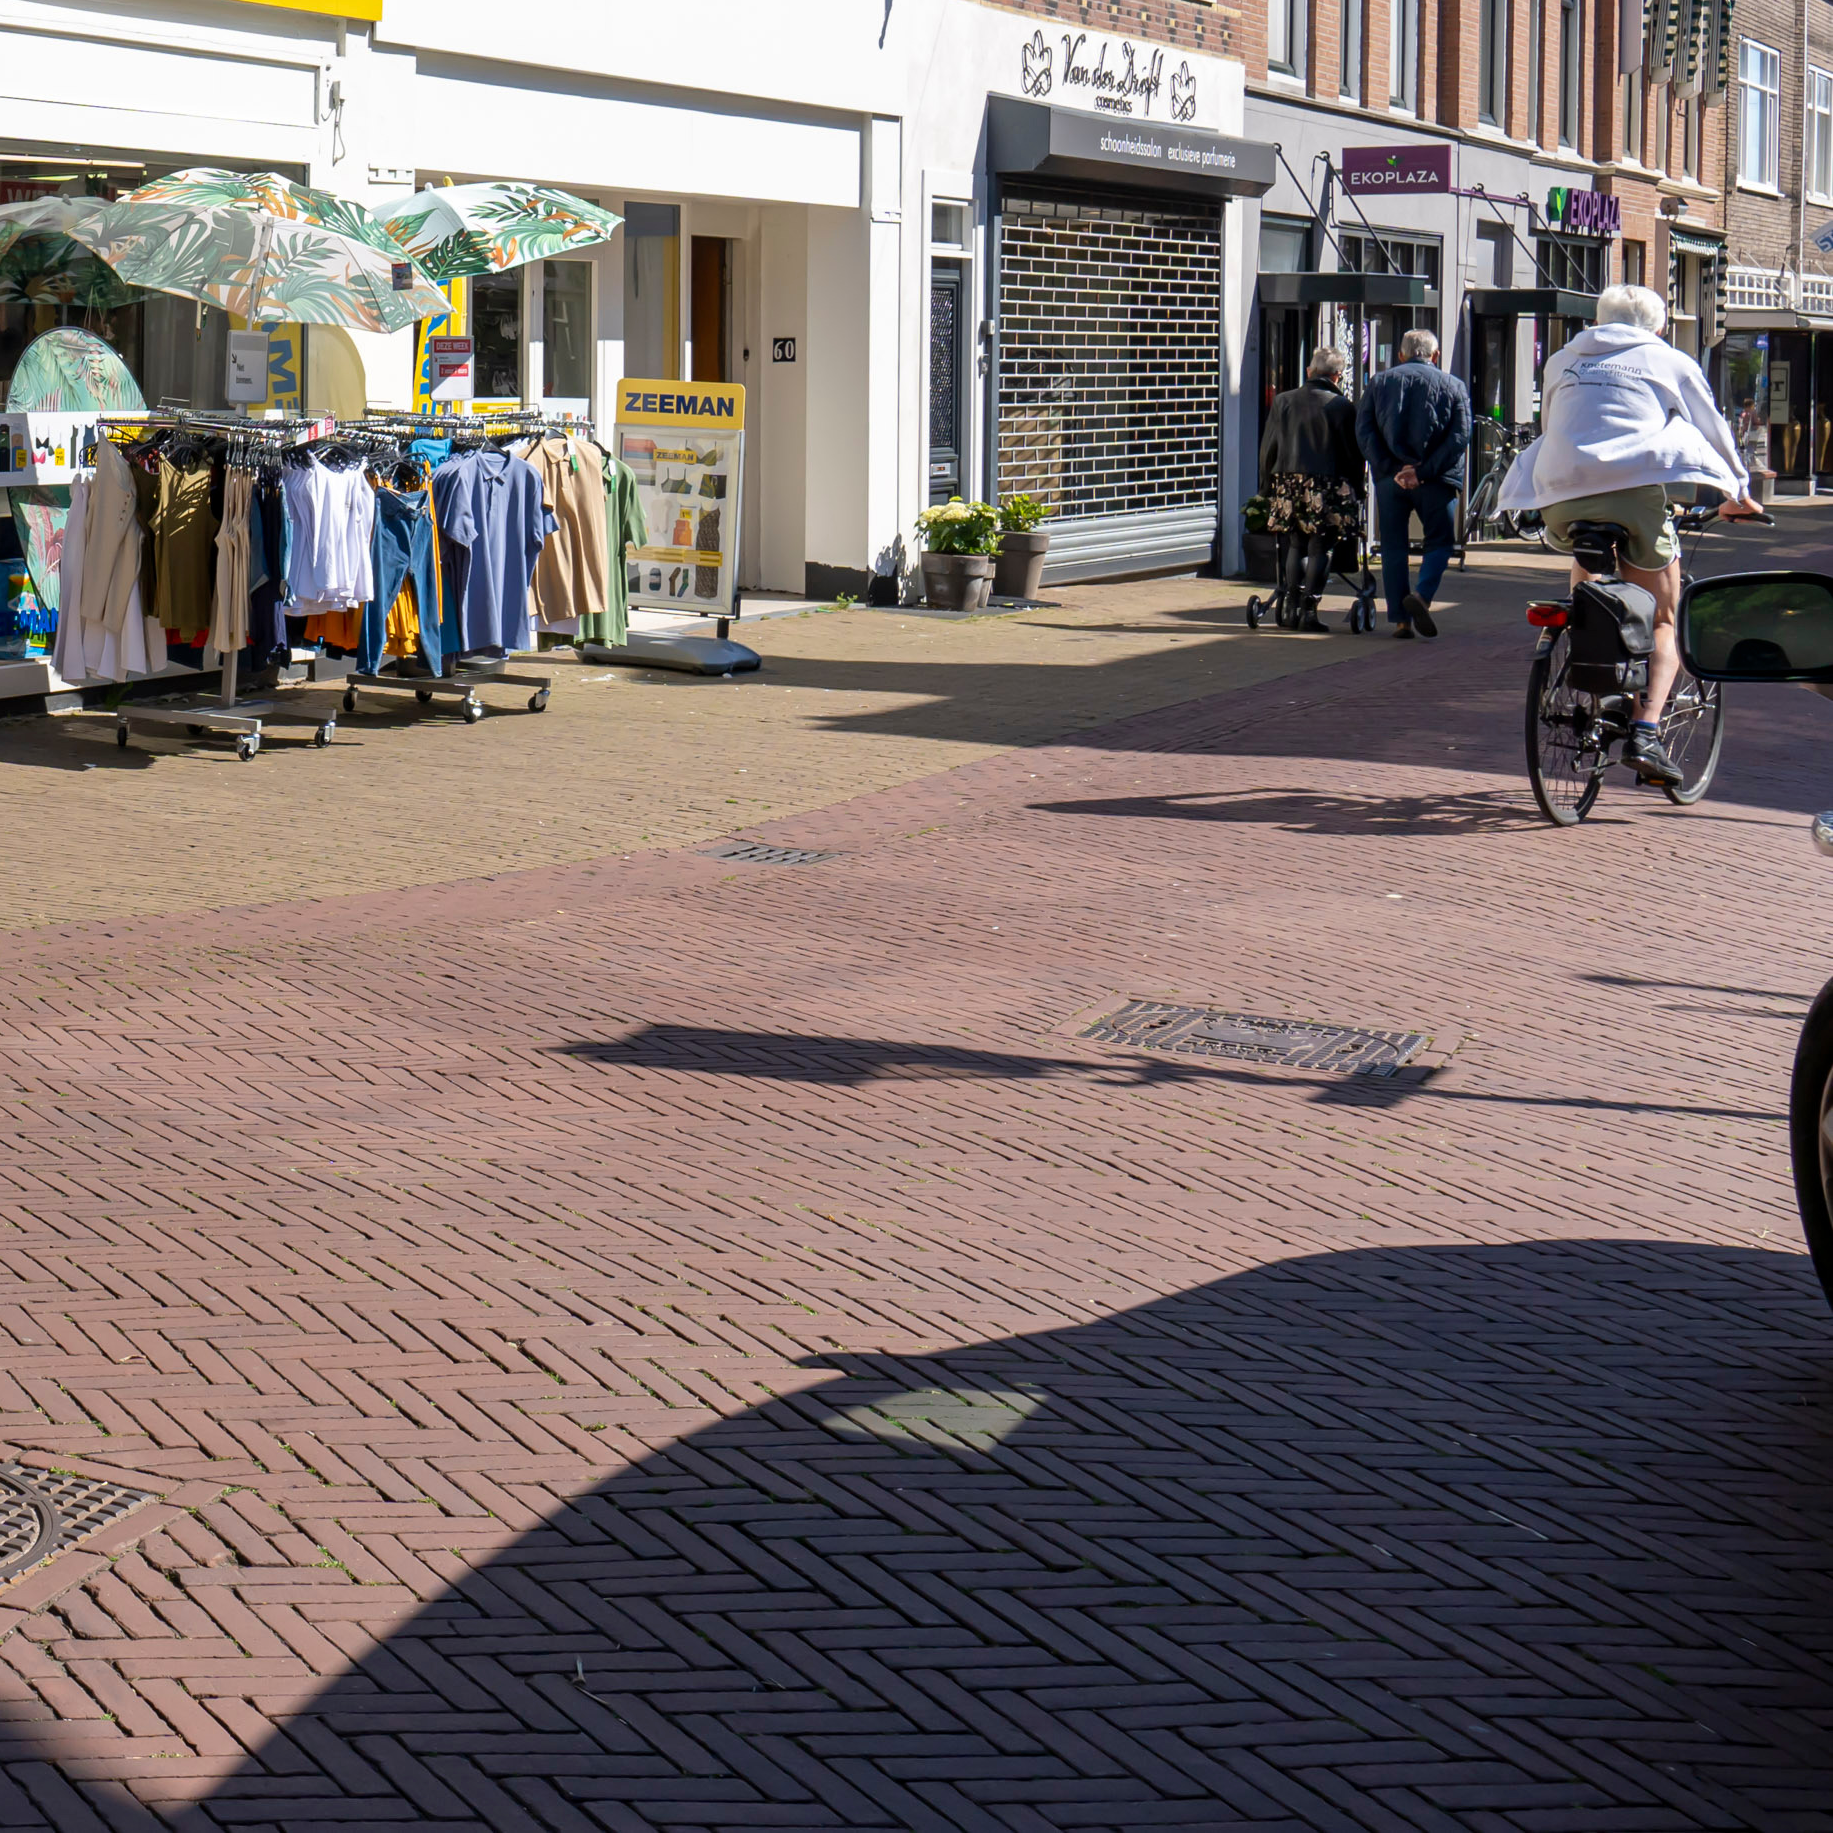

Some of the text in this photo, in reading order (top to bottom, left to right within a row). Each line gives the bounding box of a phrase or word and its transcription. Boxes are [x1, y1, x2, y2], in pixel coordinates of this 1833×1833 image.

[1061, 33, 1164, 117] Van der Drift
[1095, 95, 1133, 115] cosmetics
[1100, 131, 1236, 169] schoonheidssalon exclusieve parfumerie
[1350, 170, 1439, 185] EKOPLAZA
[1570, 188, 1622, 231] EKOPLAZA
[774, 340, 795, 360] 60
[625, 392, 735, 417] ZEEMAN
[656, 451, 694, 461] ZEEMAN
